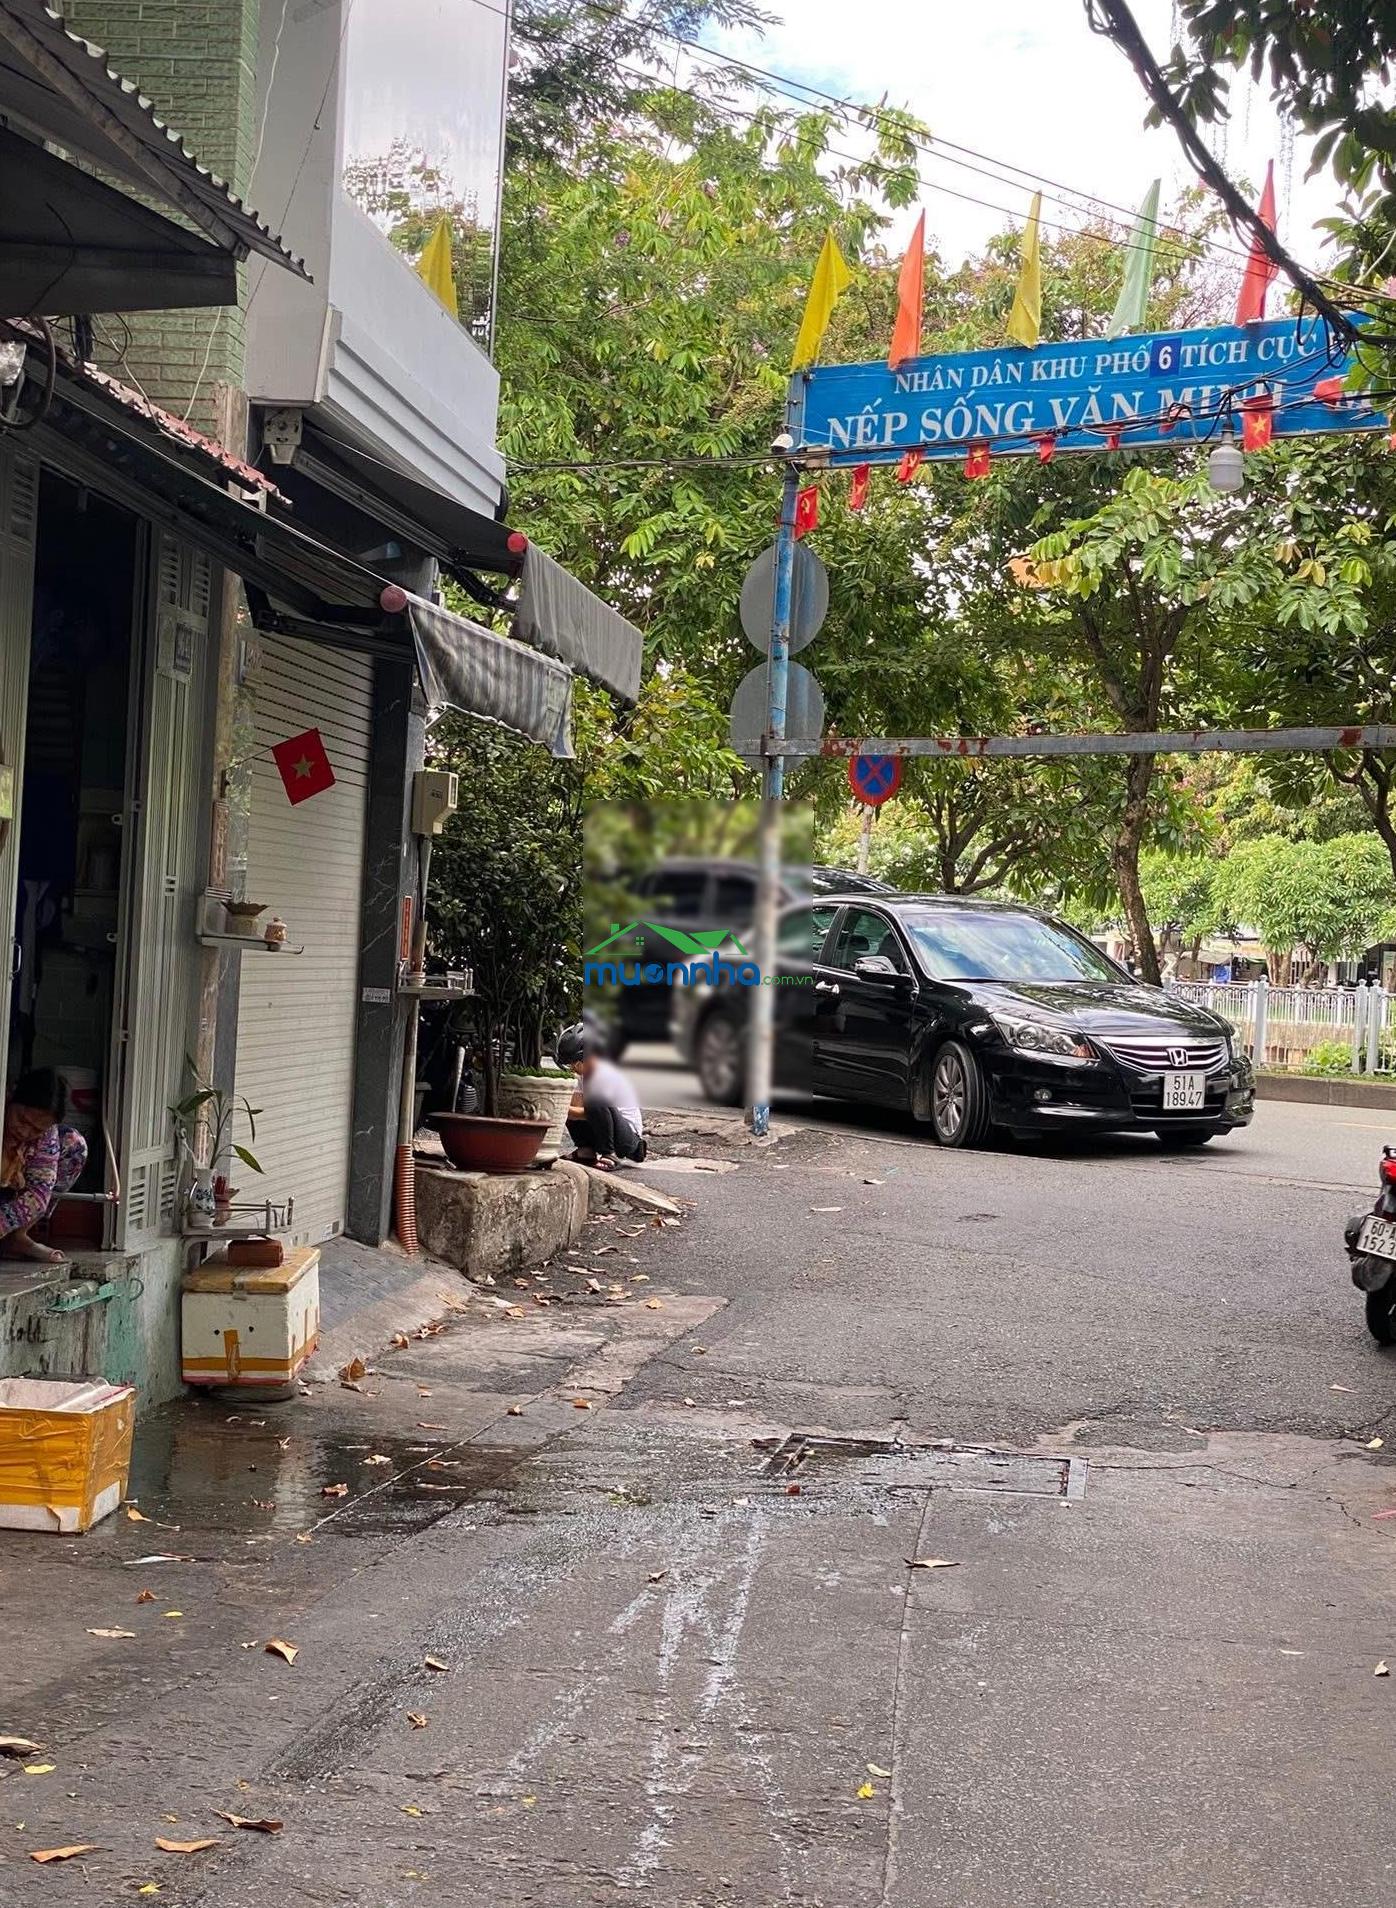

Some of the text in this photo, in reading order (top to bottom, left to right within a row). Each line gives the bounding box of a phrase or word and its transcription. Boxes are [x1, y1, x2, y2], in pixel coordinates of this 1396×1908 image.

[894, 364, 964, 394] NHÂN
[970, 359, 1025, 388] DÂN
[1030, 355, 1088, 382] KHU
[1094, 340, 1152, 376] PHỐ
[1158, 345, 1173, 370] 6
[1180, 337, 1249, 368] TÍCH
[827, 397, 908, 449] NẾP
[919, 389, 1035, 443] SỐNG
[1049, 385, 1144, 432] VĂN
[1174, 1075, 1194, 1091] 51A
